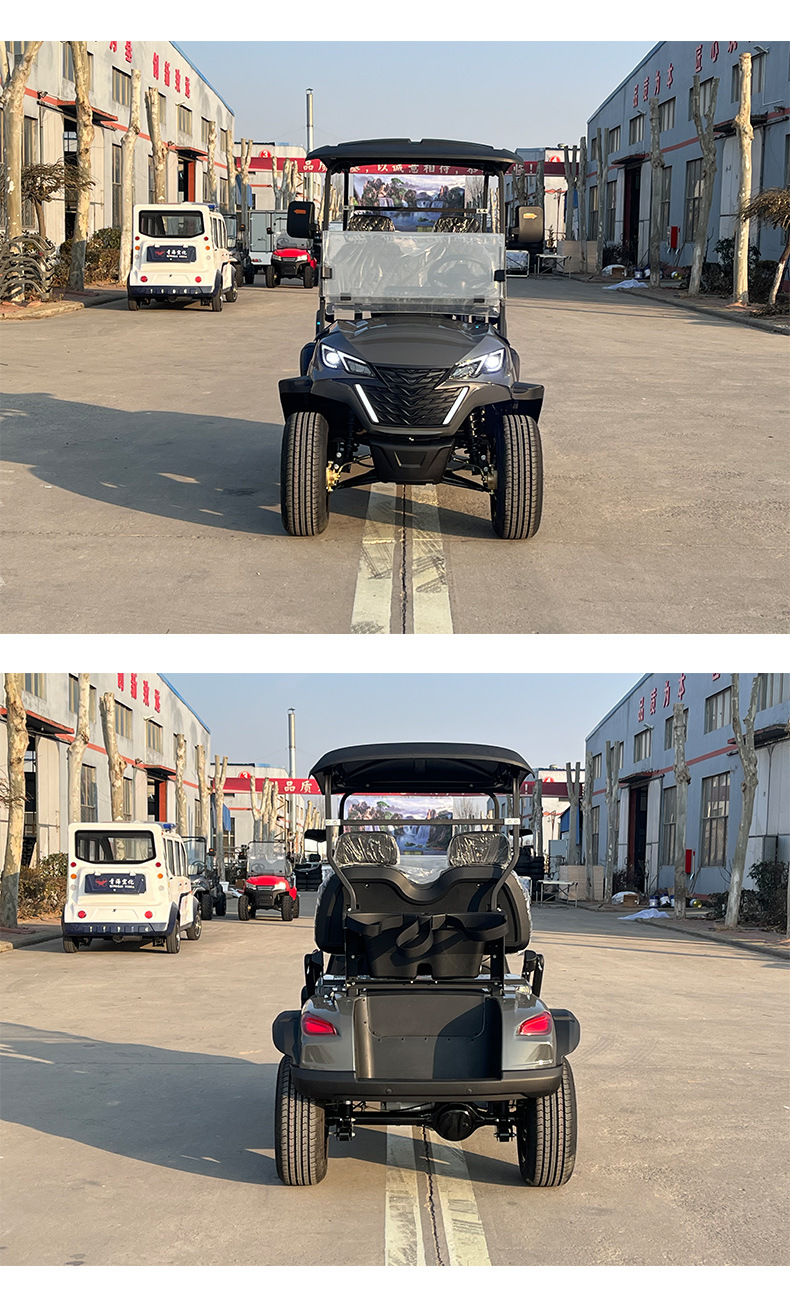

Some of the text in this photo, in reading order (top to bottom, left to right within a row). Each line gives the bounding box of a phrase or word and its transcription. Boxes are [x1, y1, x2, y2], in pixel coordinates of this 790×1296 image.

[632, 63, 675, 108] 品质为本
[638, 672, 687, 723] 品质为本
